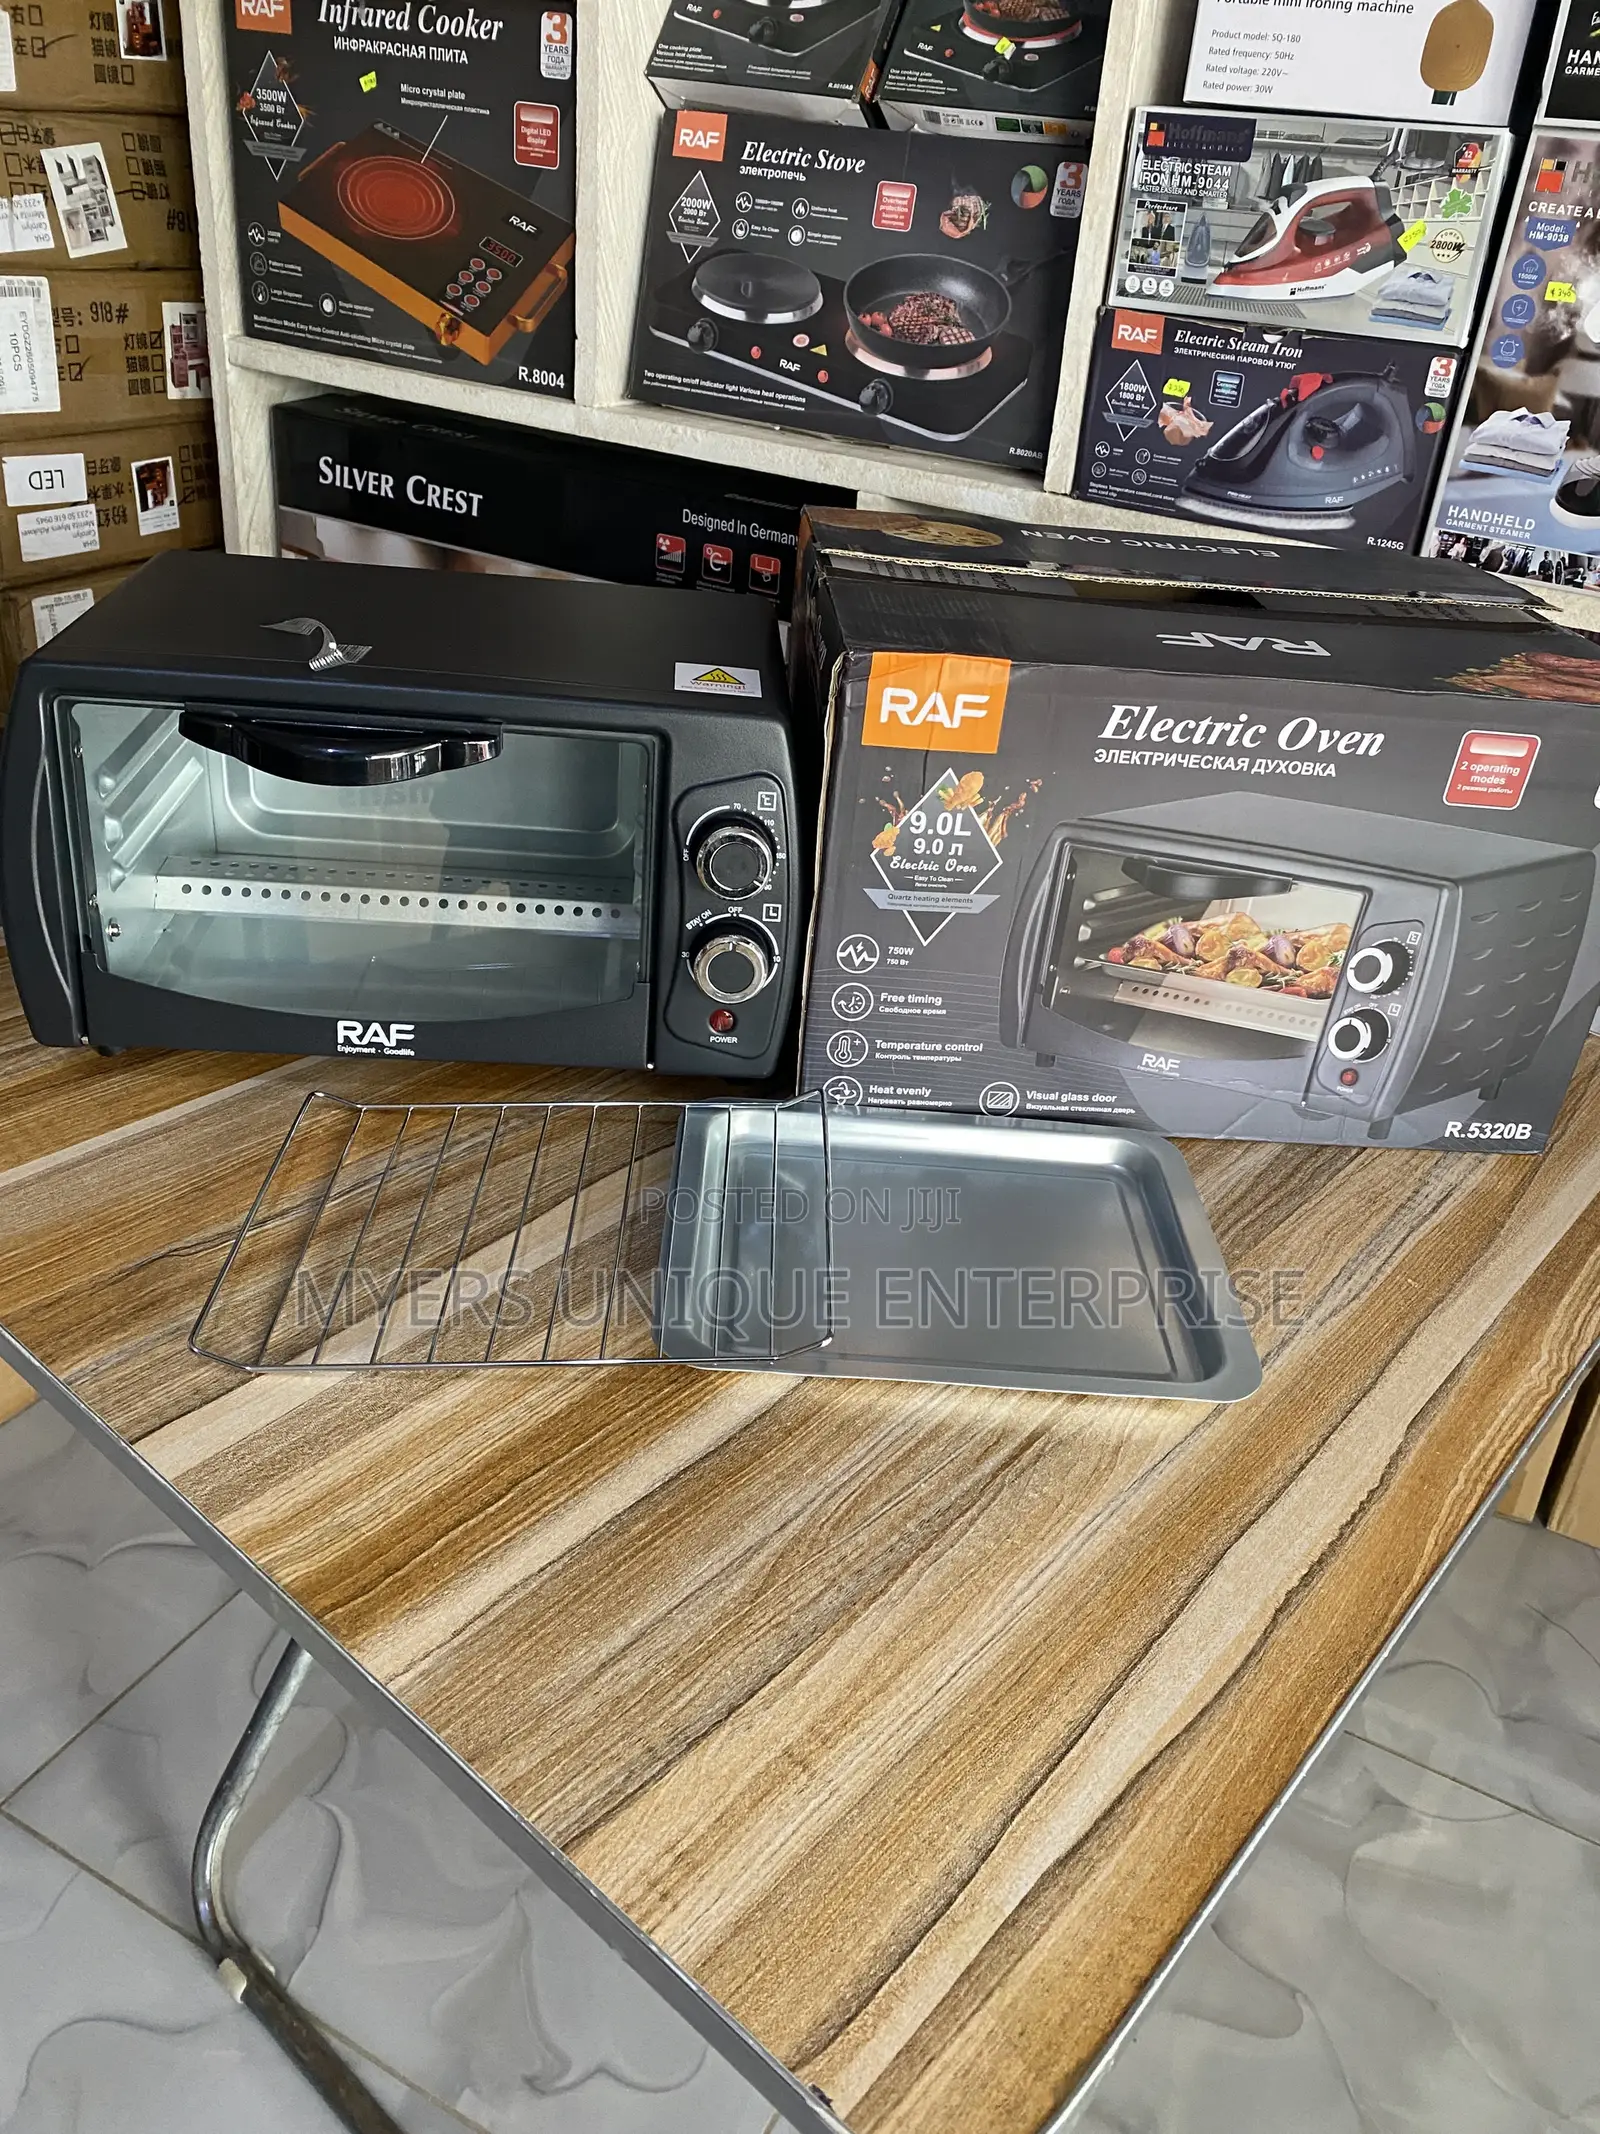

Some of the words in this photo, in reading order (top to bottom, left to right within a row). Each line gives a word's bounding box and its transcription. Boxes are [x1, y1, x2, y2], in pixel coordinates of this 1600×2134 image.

[241, 0, 284, 17] RAF
[1305, 0, 1352, 13] ironing
[1356, 1, 1415, 15] machine
[317, 0, 411, 32] Infrared
[418, 4, 504, 41] Cooker
[545, 12, 568, 45] 3
[1211, 29, 1242, 40] Product
[1243, 32, 1271, 42] model:
[1271, 33, 1302, 44] SQ-180
[14, 36, 28, 56] 左
[333, 35, 426, 59] ИНФРАКРАСНАЯ
[429, 46, 469, 65] ПЛИТА
[544, 45, 569, 55] YEARS
[1208, 46, 1231, 57] Rated
[1231, 48, 1273, 61] frequency:
[1274, 51, 1295, 61] 50Hz
[547, 54, 565, 65] ГОДА
[1205, 63, 1228, 74] Rated
[1228, 65, 1260, 77] voltage:
[1261, 67, 1289, 77] 220V~
[400, 83, 421, 95] Micro
[422, 86, 446, 99] crystal
[447, 89, 466, 100] plate
[1202, 80, 1224, 91] Rated
[1225, 83, 1254, 93] power:
[1254, 84, 1274, 94] 30W
[256, 88, 287, 103] 3500W
[259, 102, 275, 113] 3500
[520, 126, 539, 137] Digital
[539, 127, 552, 137] LED
[679, 128, 720, 149] RAF
[741, 141, 812, 167] Electric
[814, 149, 866, 174] Stove
[1463, 150, 1473, 159] 12
[739, 165, 807, 182] электропечь
[1060, 161, 1083, 190] 3
[1141, 159, 1193, 174] ELECTRIC
[1193, 163, 1232, 177] STEAM
[1139, 171, 1169, 186] IRON
[1170, 174, 1230, 191] HM-9044
[1056, 188, 1082, 198] YEARS
[1183, 188, 1198, 197] AND
[1198, 190, 1228, 199] SMARTER
[681, 197, 712, 210] 2000W
[1528, 200, 1583, 218] CREATE
[1583, 207, 1595, 219] A
[683, 207, 698, 216] 2000
[508, 215, 538, 234] RAF
[1536, 222, 1567, 234] Model:
[1528, 230, 1569, 243] HM-9038
[1430, 240, 1466, 252] 2800W
[89, 301, 130, 325] 918#
[1117, 324, 1158, 343] RAF
[1174, 328, 1225, 349] Electric
[1227, 336, 1269, 354] Steam
[1272, 342, 1303, 359] Iron
[9, 332, 23, 372] 10PCS
[1174, 347, 1236, 362] ЭЛЕКТРИЧЕСКИЙ
[1236, 354, 1274, 367] ПАРОВОЙ
[1273, 360, 1296, 371] УТЮГ
[779, 358, 802, 373] RAF
[1433, 356, 1453, 377] 3
[517, 365, 566, 389] R.8004
[1429, 376, 1451, 384] YEARS
[644, 369, 655, 378] Two
[655, 371, 682, 384] operating
[699, 379, 725, 390] indicator
[725, 383, 739, 393] light
[739, 385, 761, 396] Various
[761, 389, 775, 398] heat
[774, 392, 806, 404] operations
[1119, 381, 1148, 394] 1800W
[1119, 391, 1135, 401] 1800
[28, 469, 64, 490] LED
[1325, 496, 1343, 504] RAF
[682, 508, 735, 533] Designed
[736, 520, 747, 536] In
[1447, 505, 1536, 531] HANDHELD
[1020, 529, 1112, 544] OVEN
[1445, 518, 1488, 532] GARMENT
[1488, 526, 1531, 540] STEAMER
[1120, 538, 1281, 558] ELECTRIC
[1367, 537, 1404, 551] R.1245G
[1156, 631, 1332, 657] RAF
[689, 680, 746, 690] Warning!
[879, 687, 990, 729] RAF
[1097, 704, 1267, 748] Electric
[1277, 716, 1386, 757] Oven
[1093, 748, 1250, 773] ЭЛЕКТРИЧЕСКАЯ
[1251, 757, 1338, 778] ДУХОВКА
[1459, 760, 1469, 771] 2
[1469, 763, 1521, 777] operating
[1469, 774, 1506, 785] modes
[1456, 783, 1463, 791] 2
[1488, 787, 1514, 795] работы
[764, 819, 775, 827] 110
[909, 810, 972, 837] 9.0L
[913, 837, 944, 856] 9.0
[948, 843, 964, 856] л
[889, 855, 940, 872] Electric
[945, 858, 978, 873] Oven
[914, 875, 929, 883] Easy
[887, 893, 912, 902] Quartz
[912, 894, 940, 905] heating
[941, 896, 974, 905] elements
[728, 906, 744, 914] OFF
[685, 915, 702, 931] STAY
[701, 909, 713, 920] ON
[888, 946, 914, 956] 750W
[886, 958, 899, 966] 750
[880, 992, 906, 1004] Free
[907, 993, 943, 1006] timing
[878, 1005, 922, 1015] Свободное
[922, 1008, 947, 1016] время
[337, 1020, 415, 1047] RAF
[710, 1036, 738, 1044] POWER
[337, 1045, 376, 1054] Enjoyment
[383, 1047, 415, 1057] Goodlife
[874, 1039, 943, 1053] Temperature
[944, 1042, 984, 1053] control
[875, 1052, 912, 1062] Контроль
[913, 1054, 962, 1063] температуры
[1141, 1053, 1181, 1071] RAF
[869, 1084, 895, 1096] Heat
[896, 1085, 932, 1098] evenly
[1026, 1090, 1058, 1102] Visual
[1060, 1091, 1090, 1104] glass
[1091, 1092, 1117, 1104] door
[867, 1096, 906, 1106] Нагревать
[906, 1098, 953, 1108] равномерно
[1025, 1102, 1069, 1113] Визуальная
[1069, 1104, 1113, 1113] стеклянная
[1112, 1106, 1136, 1115] дверь
[1444, 1120, 1533, 1140] R.5320B
